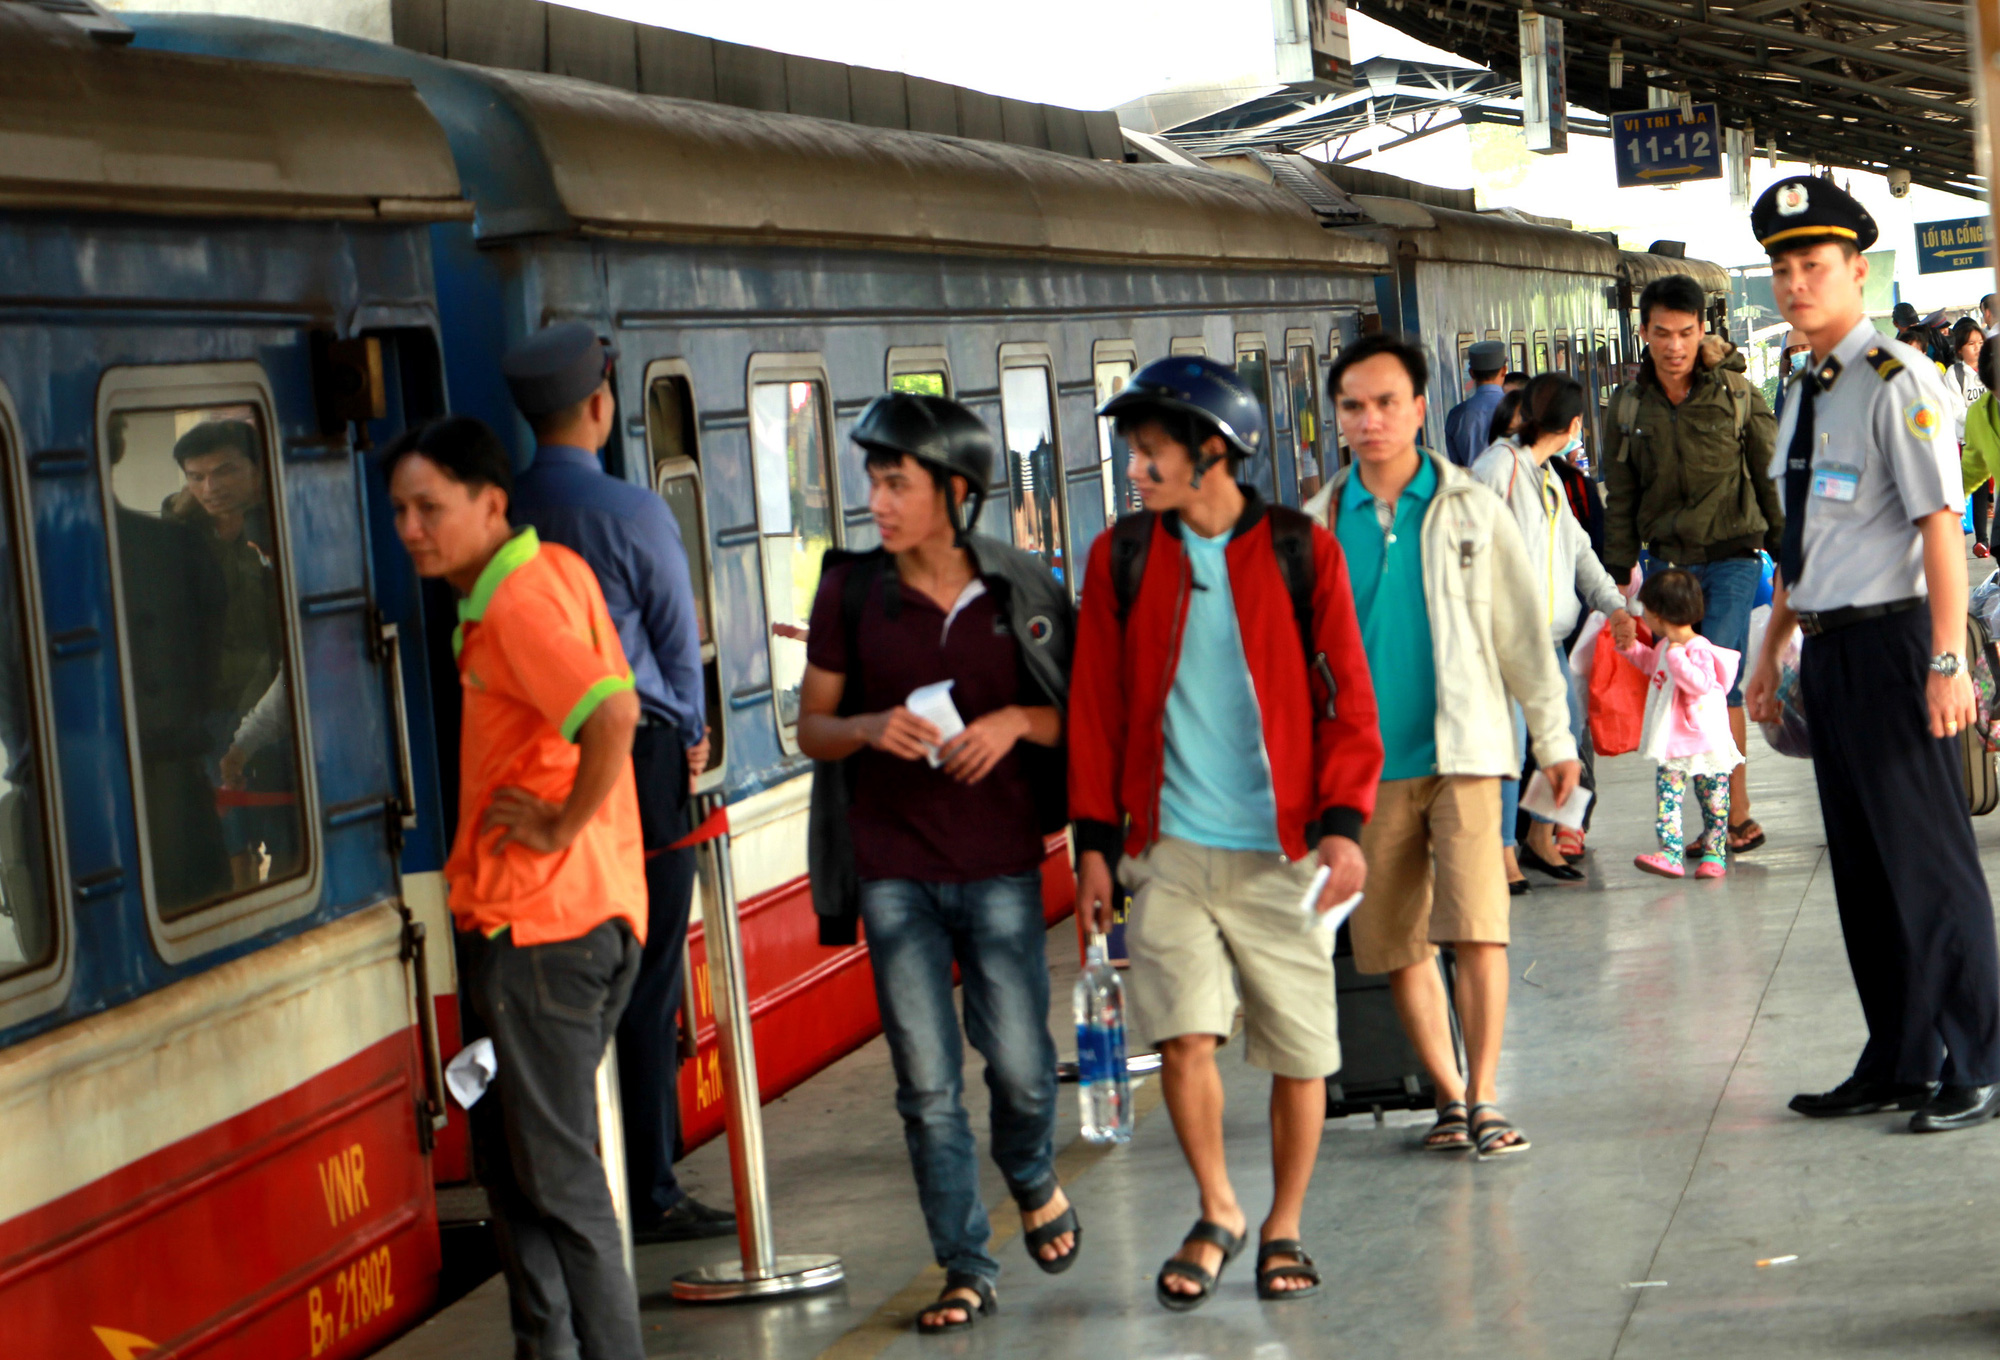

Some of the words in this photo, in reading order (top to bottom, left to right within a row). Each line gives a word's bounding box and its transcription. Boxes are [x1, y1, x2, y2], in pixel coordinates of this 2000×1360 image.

[1624, 118, 1640, 133] VỊ
[1645, 113, 1670, 129] TRÍ
[1627, 131, 1711, 164] 11-12
[1923, 225, 1939, 248] LỐI
[1941, 229, 1955, 246] RA
[1956, 219, 1984, 245] CỔNG
[1953, 256, 1974, 266] EXIT
[318, 1143, 370, 1228] VNR
[336, 1244, 395, 1340] 21802
